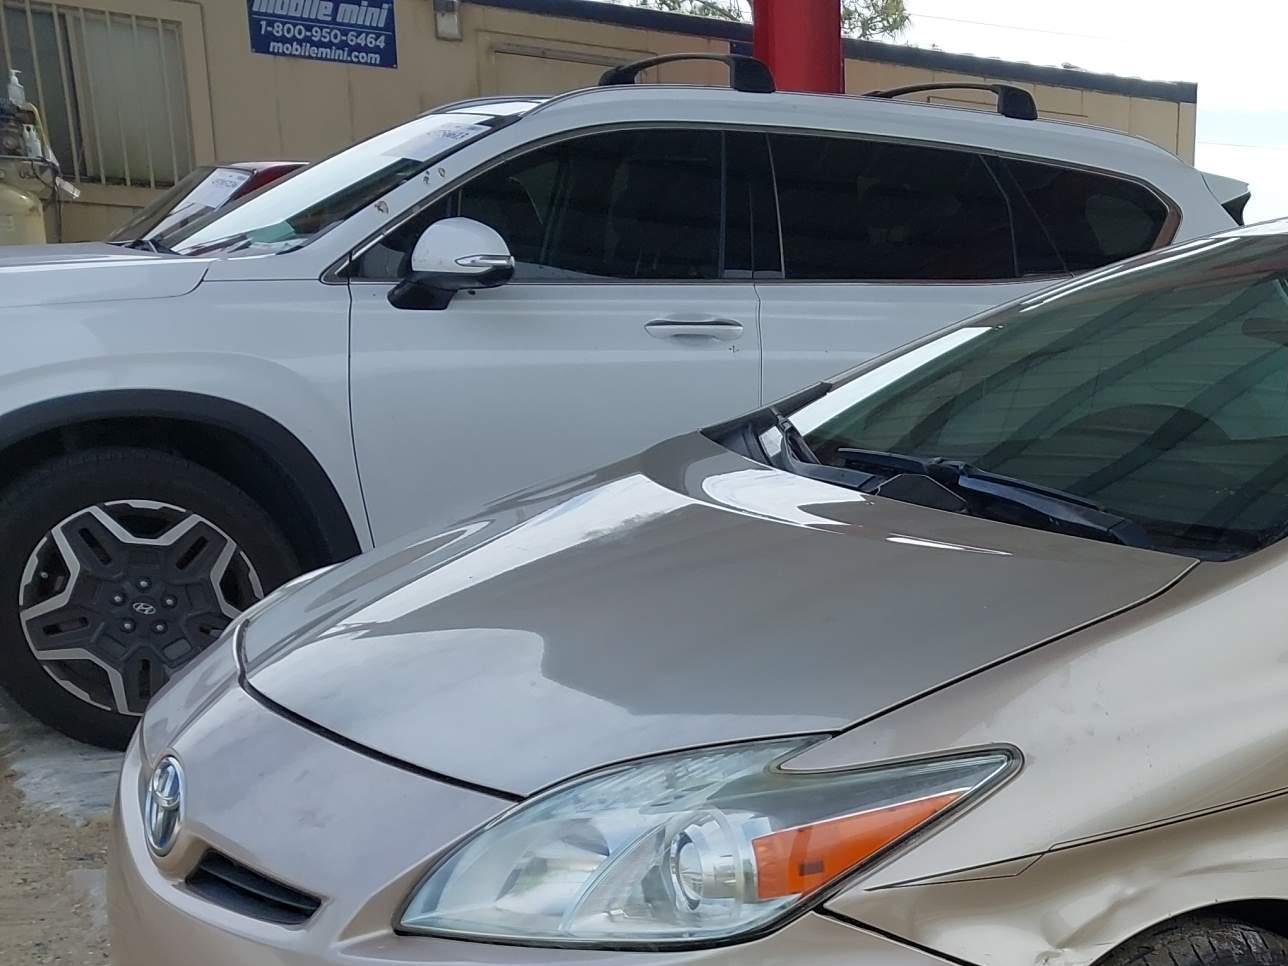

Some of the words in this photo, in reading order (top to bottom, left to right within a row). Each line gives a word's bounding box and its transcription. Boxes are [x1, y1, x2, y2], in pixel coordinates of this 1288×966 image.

[336, 1, 390, 28] mini
[259, 21, 386, 49] 1-800-950-6464
[269, 42, 381, 64] mobilemini.com
